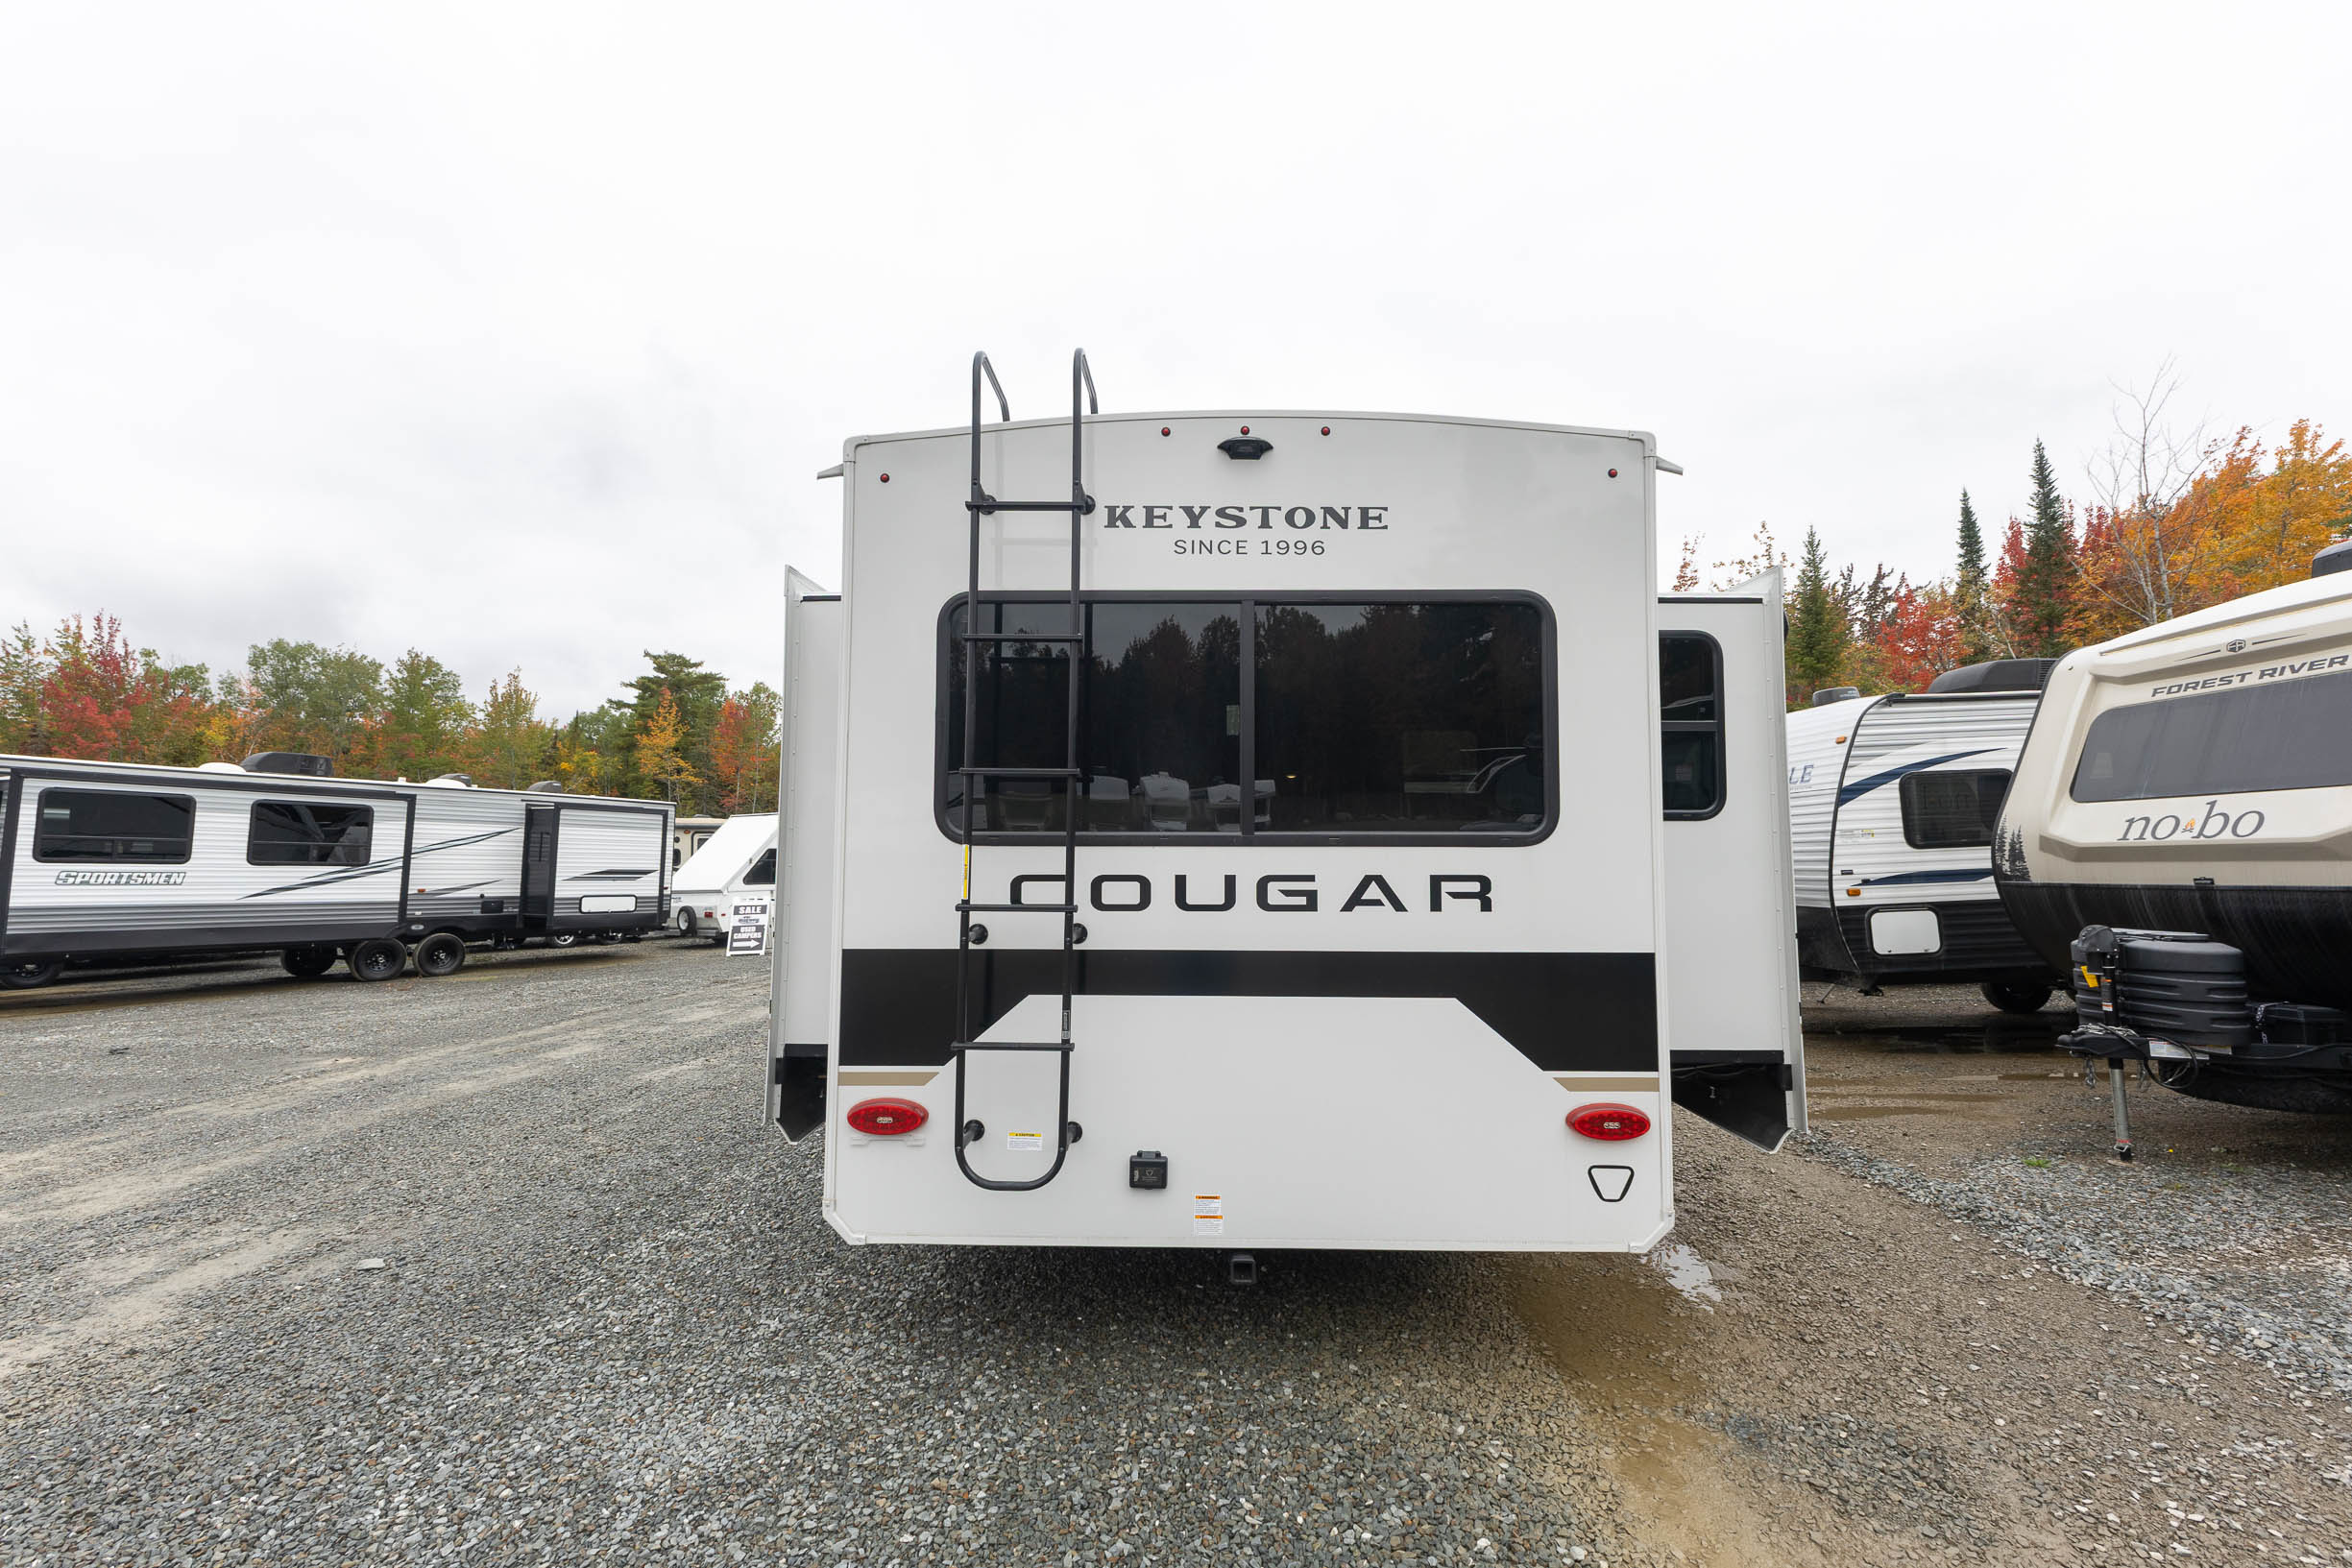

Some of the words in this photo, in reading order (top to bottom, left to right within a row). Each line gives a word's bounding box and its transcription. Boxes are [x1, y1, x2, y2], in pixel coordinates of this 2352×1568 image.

[1103, 505, 1389, 530] KEYSTONE
[1174, 540, 1249, 555] SINCE
[1260, 540, 1325, 556] 1996
[2150, 671, 2253, 697] FOREST
[2258, 654, 2350, 680] RIVER
[55, 870, 186, 885] SPORTSMEN
[1010, 874, 1492, 912] COUGAR
[739, 905, 763, 914] SALE
